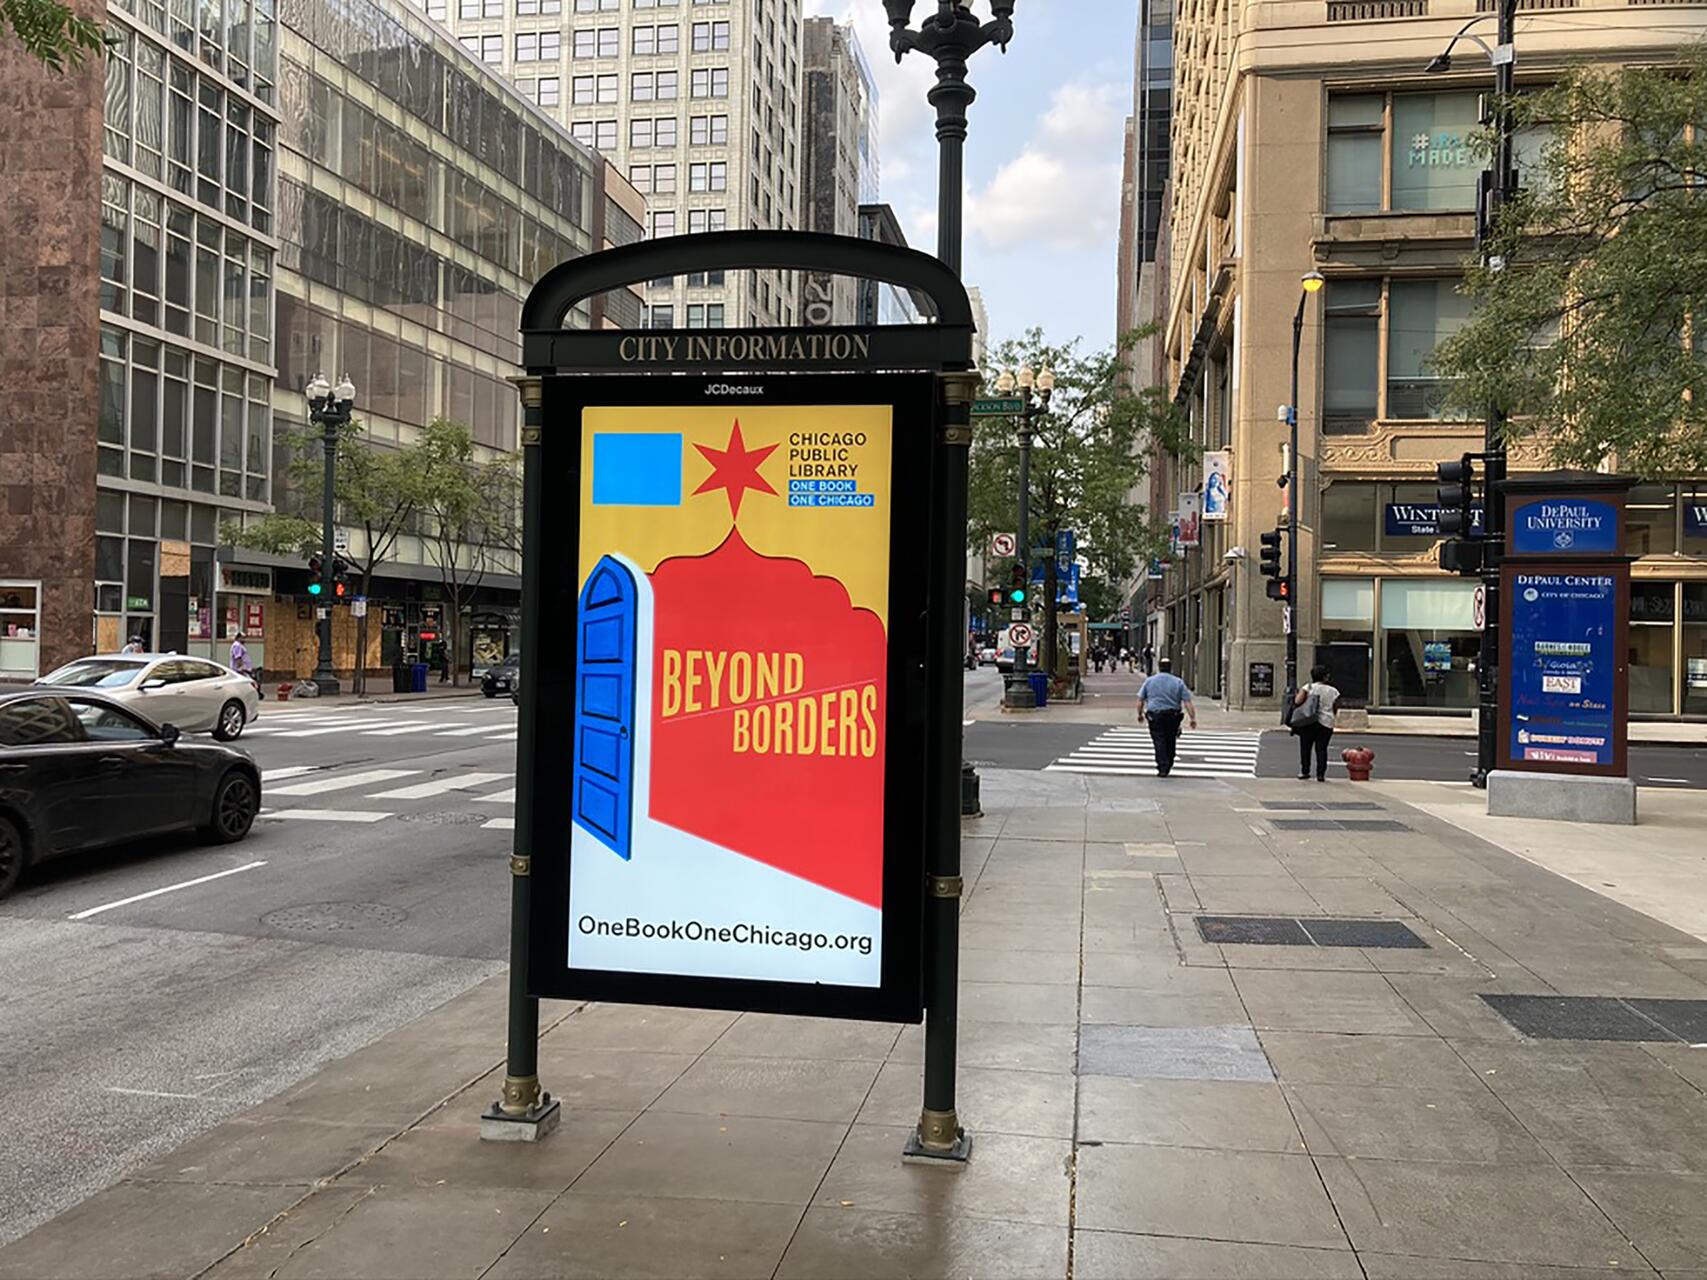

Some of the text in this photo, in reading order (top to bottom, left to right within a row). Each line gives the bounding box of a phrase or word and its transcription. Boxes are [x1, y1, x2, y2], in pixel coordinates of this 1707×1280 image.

[619, 334, 870, 362] CITY INFORMATION
[704, 384, 764, 395] JCDecaux
[789, 432, 867, 446] CHICAGO
[789, 448, 849, 461] PUBLIC
[789, 464, 859, 477] LIBRARY
[791, 481, 853, 491] ONE BOOK
[791, 495, 872, 505] ONE CHICAGO
[1392, 506, 1484, 521] WINTT
[1527, 516, 1602, 529] UNIVERSITY
[1411, 525, 1434, 534] State
[1564, 575, 1612, 586] CENTER
[661, 649, 804, 717] BEYOND
[733, 684, 878, 758] BORDERS
[578, 915, 873, 955] OneBookOneChicago.org
